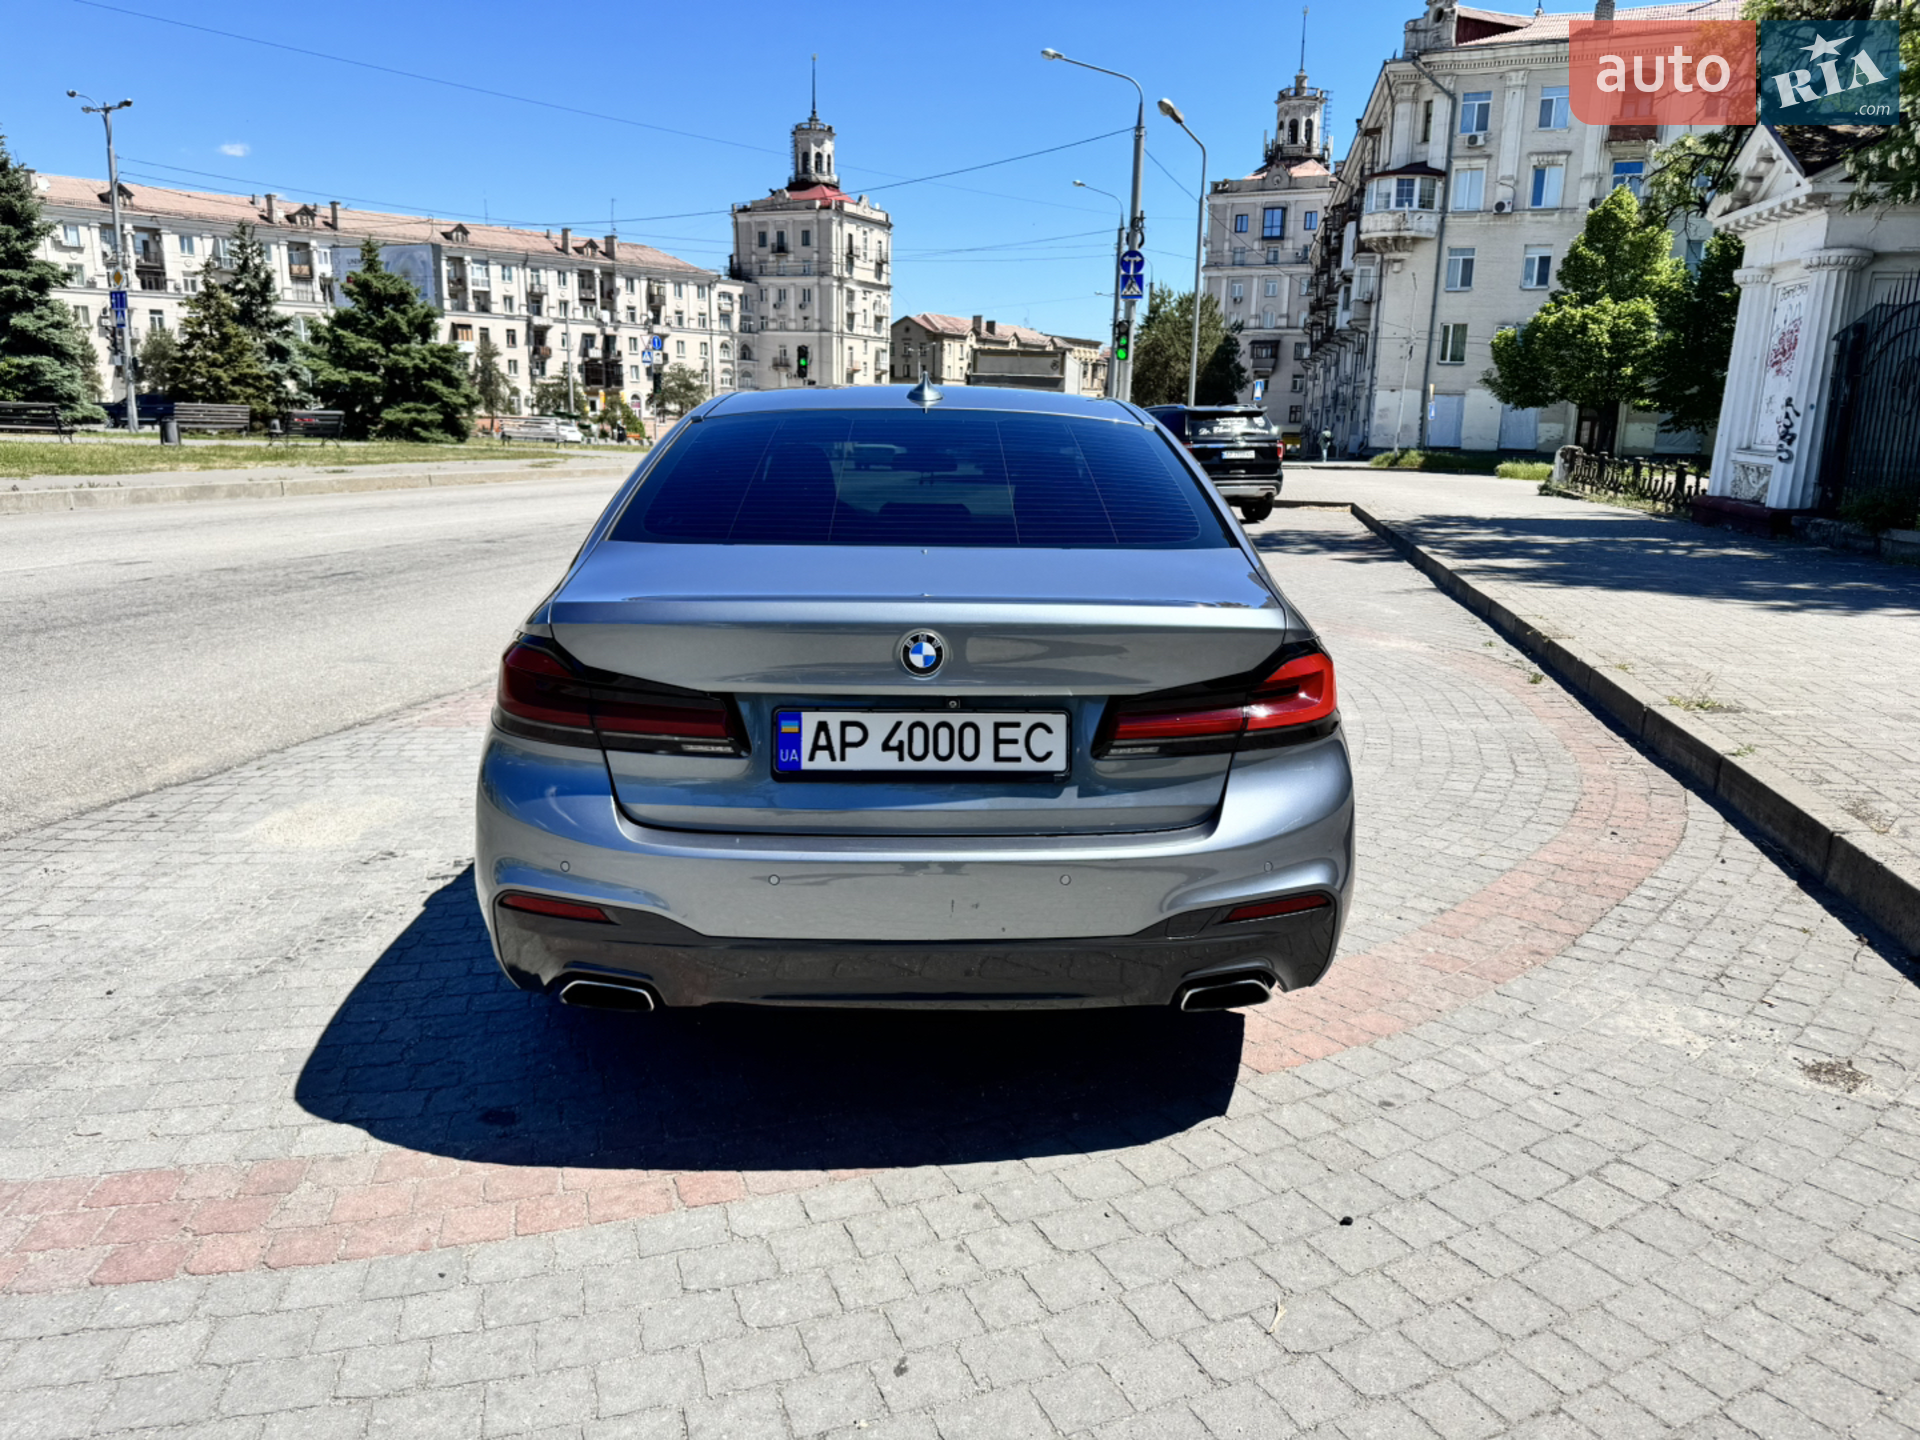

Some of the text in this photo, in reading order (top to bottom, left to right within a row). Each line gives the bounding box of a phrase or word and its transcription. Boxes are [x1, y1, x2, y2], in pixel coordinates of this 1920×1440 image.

[905, 634, 942, 649] BMW
[808, 720, 1055, 763] AP 4000 EC
[779, 748, 799, 762] UA
